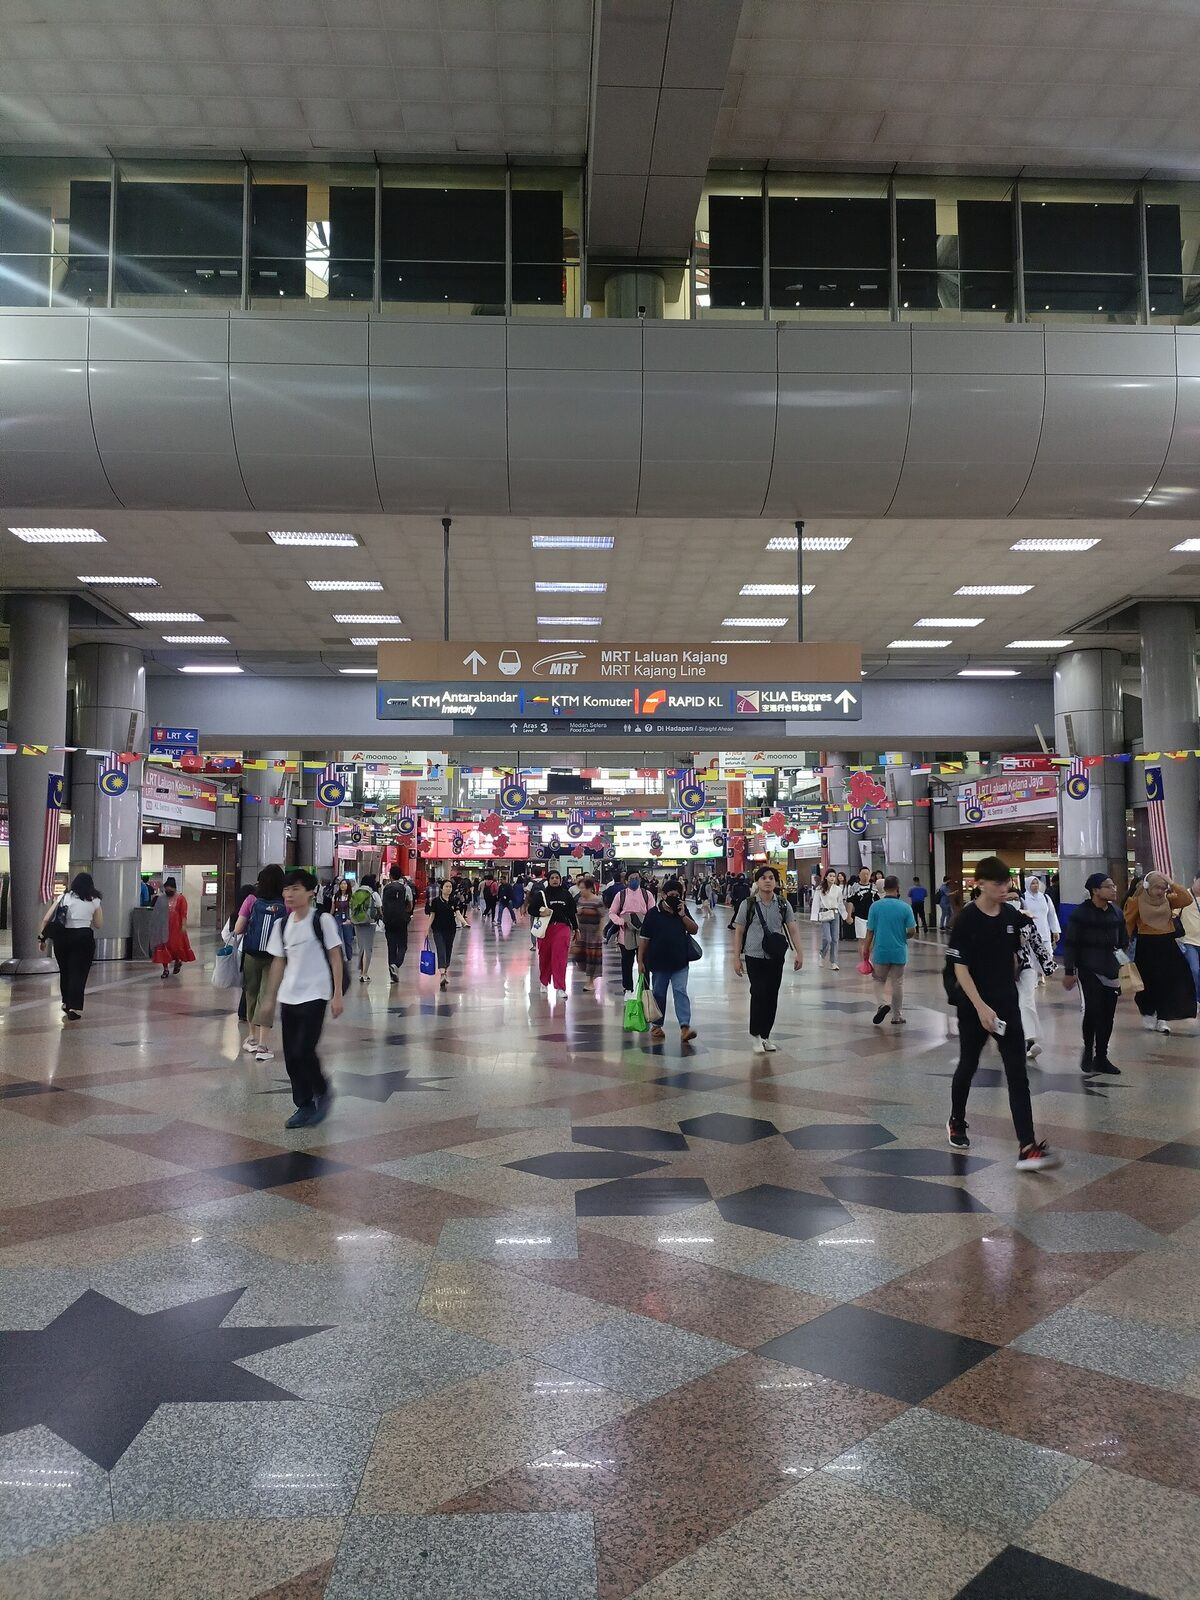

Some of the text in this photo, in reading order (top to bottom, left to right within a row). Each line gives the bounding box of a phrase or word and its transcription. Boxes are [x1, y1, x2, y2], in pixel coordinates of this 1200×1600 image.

[601, 651, 728, 665] MRT Laluan Kajang
[550, 663, 579, 675] MRT
[601, 665, 706, 679] MRT Kajang Line
[411, 691, 518, 708] KTM Antarabandar
[551, 696, 633, 707] KTM Komuter
[668, 696, 723, 707] RAPID KL
[761, 691, 832, 705] KLIA Ekspres
[441, 704, 477, 715] Intercity
[540, 723, 548, 733] 3
[146, 772, 157, 787] LRT
[989, 783, 1008, 794] Laluan
[1008, 779, 1028, 791] Kelana
[1028, 776, 1044, 789] Jaya
